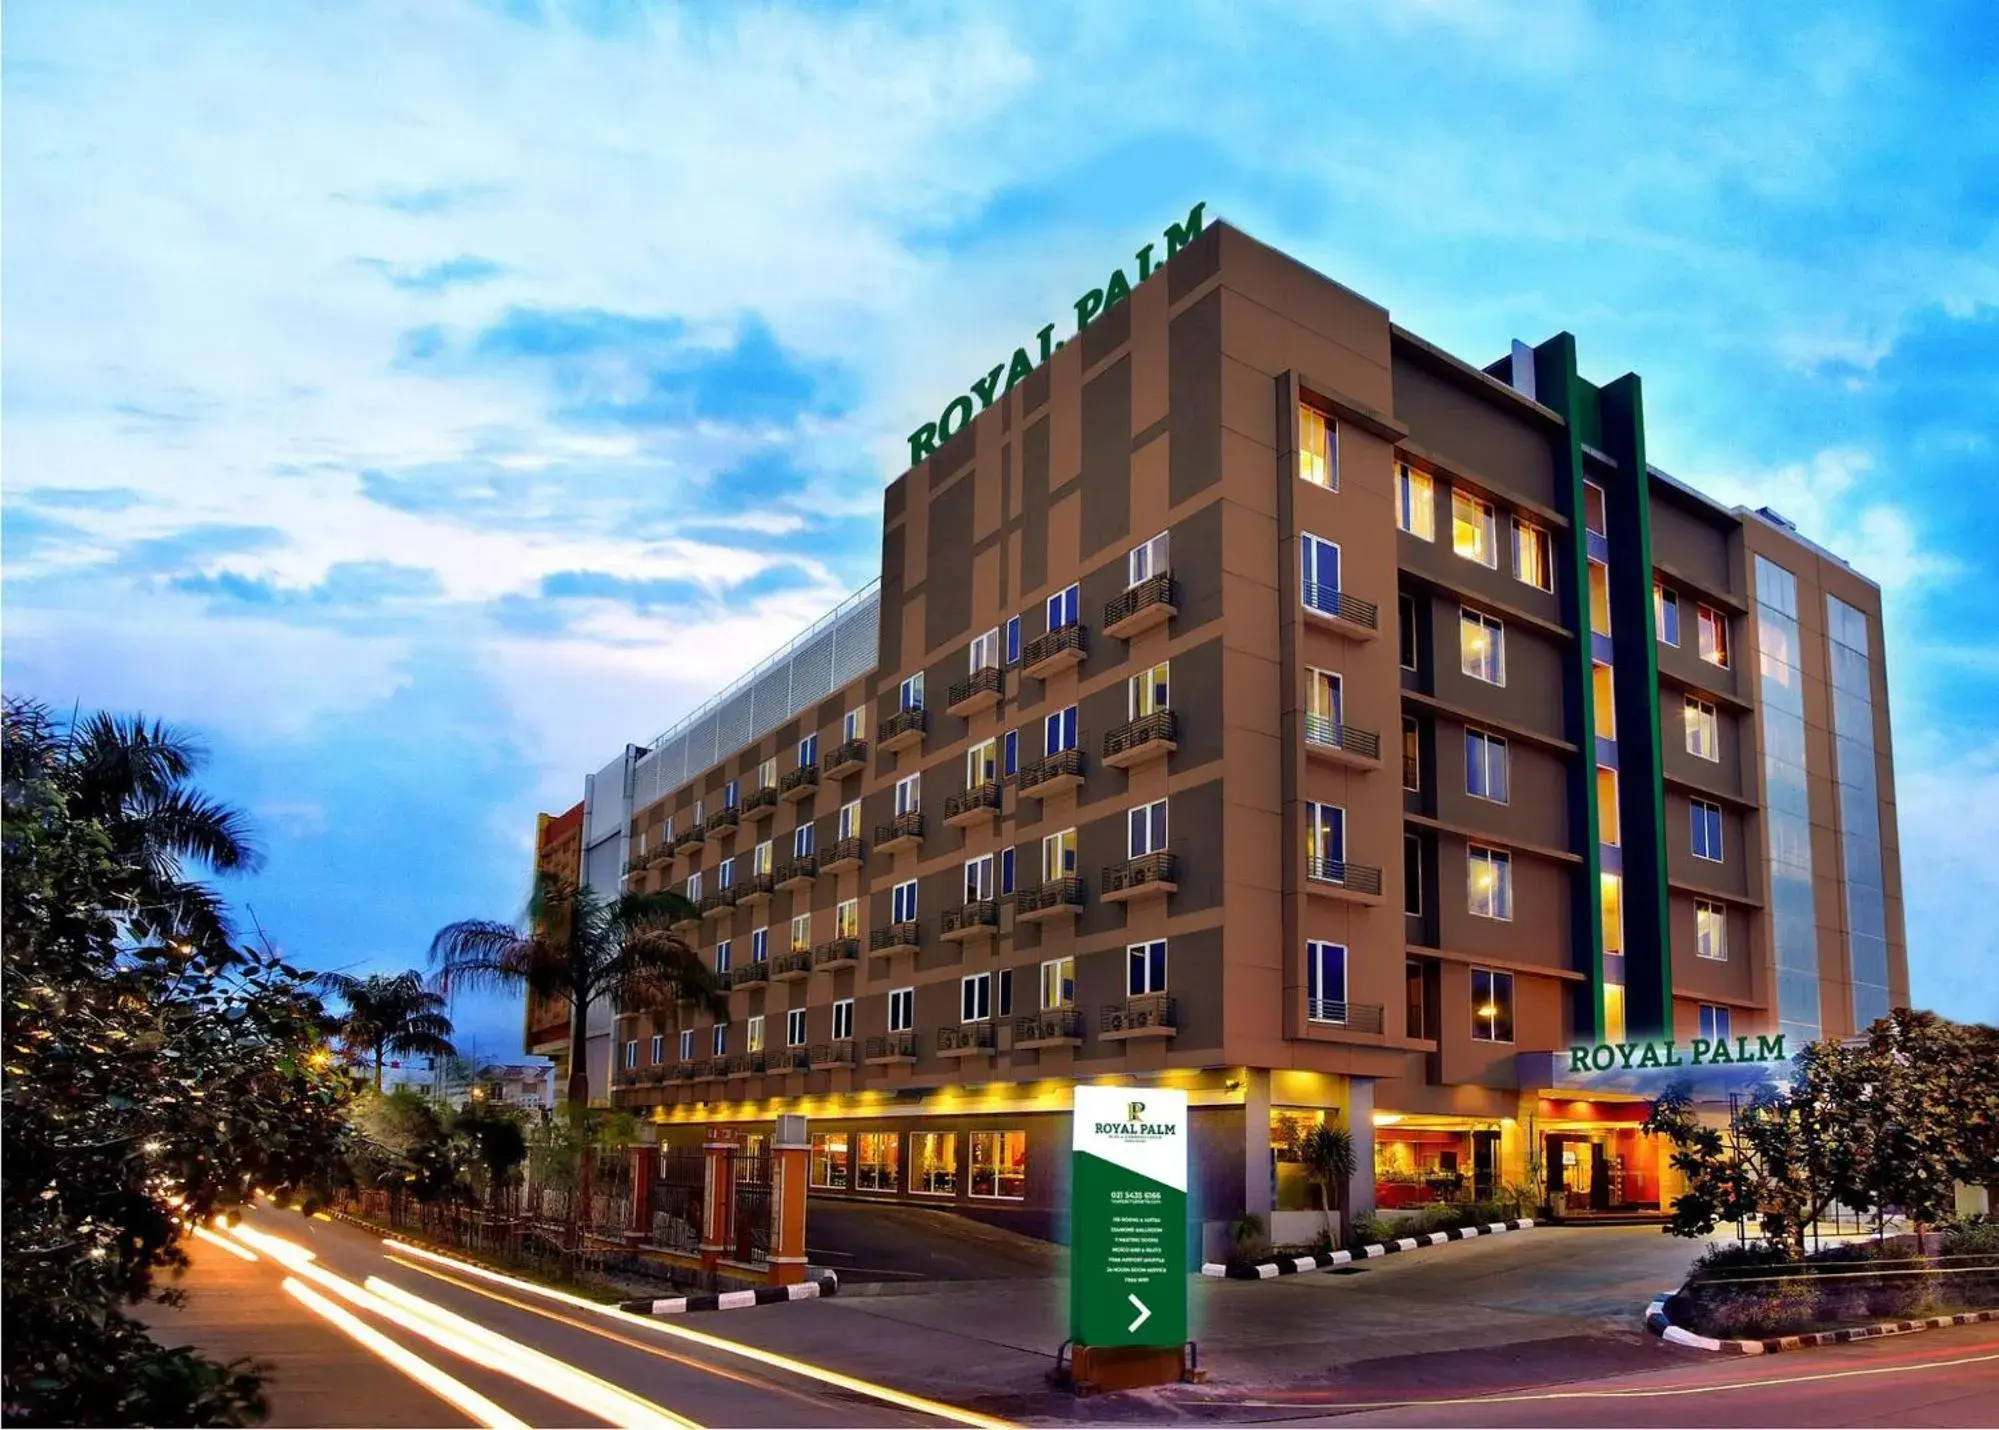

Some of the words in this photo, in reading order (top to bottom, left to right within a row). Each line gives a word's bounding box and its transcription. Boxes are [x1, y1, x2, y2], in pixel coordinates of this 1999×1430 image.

[907, 322, 1064, 467] ROYAL
[1073, 201, 1206, 331] PALM
[1568, 1040, 1683, 1072] ROYAL
[1690, 1034, 1786, 1065] PALM
[1095, 1122, 1138, 1134] ROYAL
[1140, 1123, 1176, 1135] PALM
